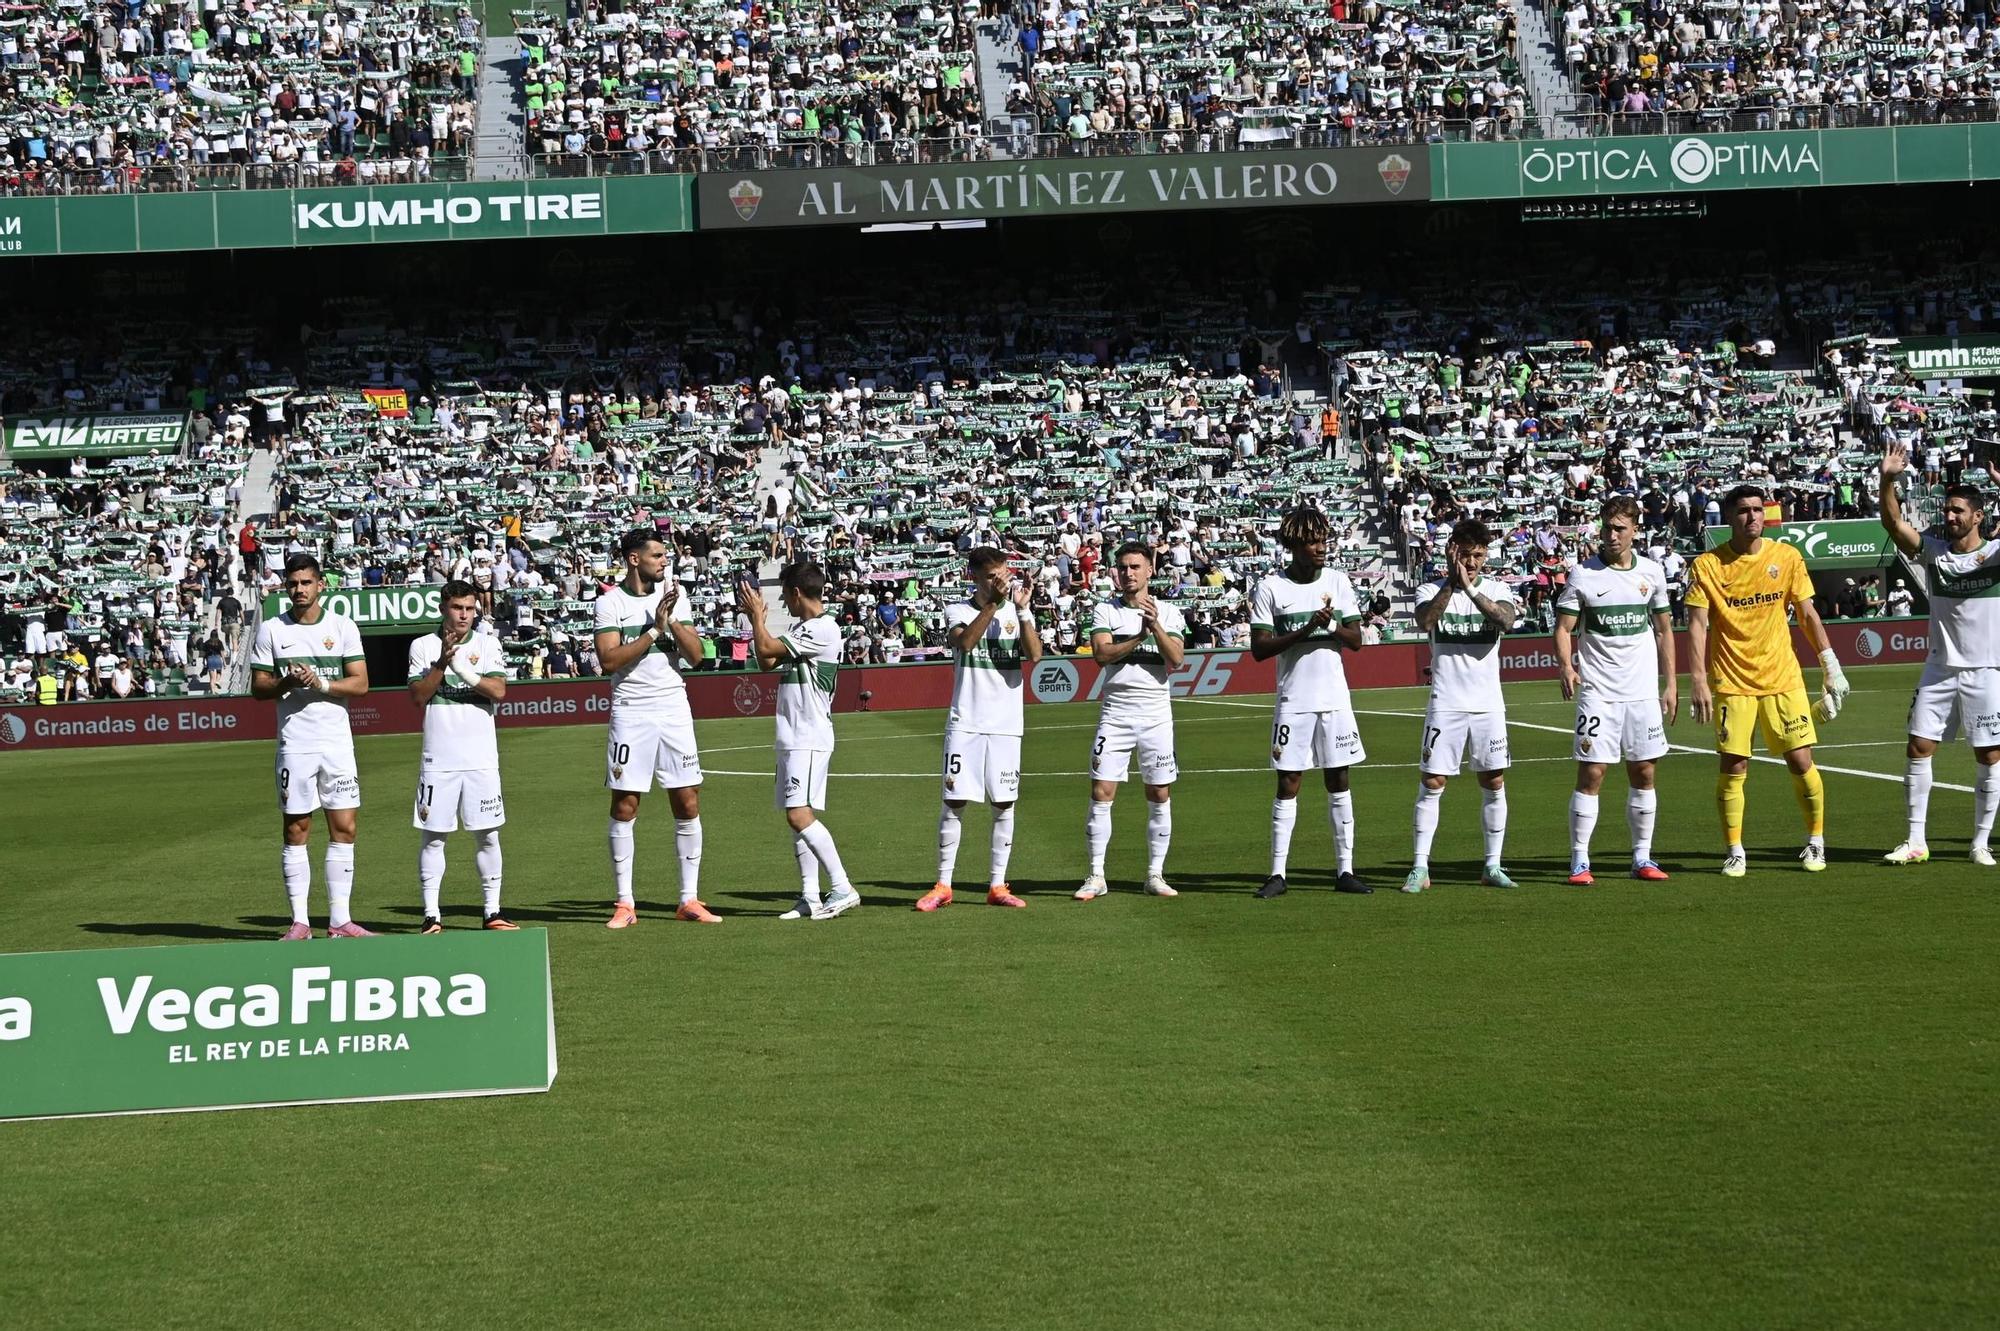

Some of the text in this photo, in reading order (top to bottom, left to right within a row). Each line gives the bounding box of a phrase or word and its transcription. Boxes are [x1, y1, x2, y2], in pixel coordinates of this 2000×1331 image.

[799, 161, 1338, 216] AL MARTÍNEZ VALERO
[298, 192, 602, 229] KUMHO TIRE
[1908, 340, 1970, 368] umh
[101, 415, 176, 425] ELECTRICIDAD
[90, 427, 182, 445] MATEU
[1828, 543, 1875, 555] Seguros
[1038, 667, 1071, 684] EA
[1038, 683, 1072, 693] SPORTS
[493, 695, 610, 717] ranadas de
[1721, 706, 1727, 727] 1
[34, 712, 237, 737] Granadas de Elche
[1576, 715, 1601, 737] 22
[1647, 725, 1662, 734] Next
[1783, 718, 1799, 726] Next
[1273, 723, 1290, 746] 18
[1335, 734, 1351, 742] Next
[1423, 726, 1441, 749] 17
[1489, 738, 1505, 746] Next
[613, 742, 630, 765] 10
[1094, 736, 1106, 756] 3
[944, 753, 961, 775] 15
[281, 768, 290, 789] 9
[419, 783, 434, 806] 11
[168, 1033, 410, 1063] EL REY DE LA FIBRA
